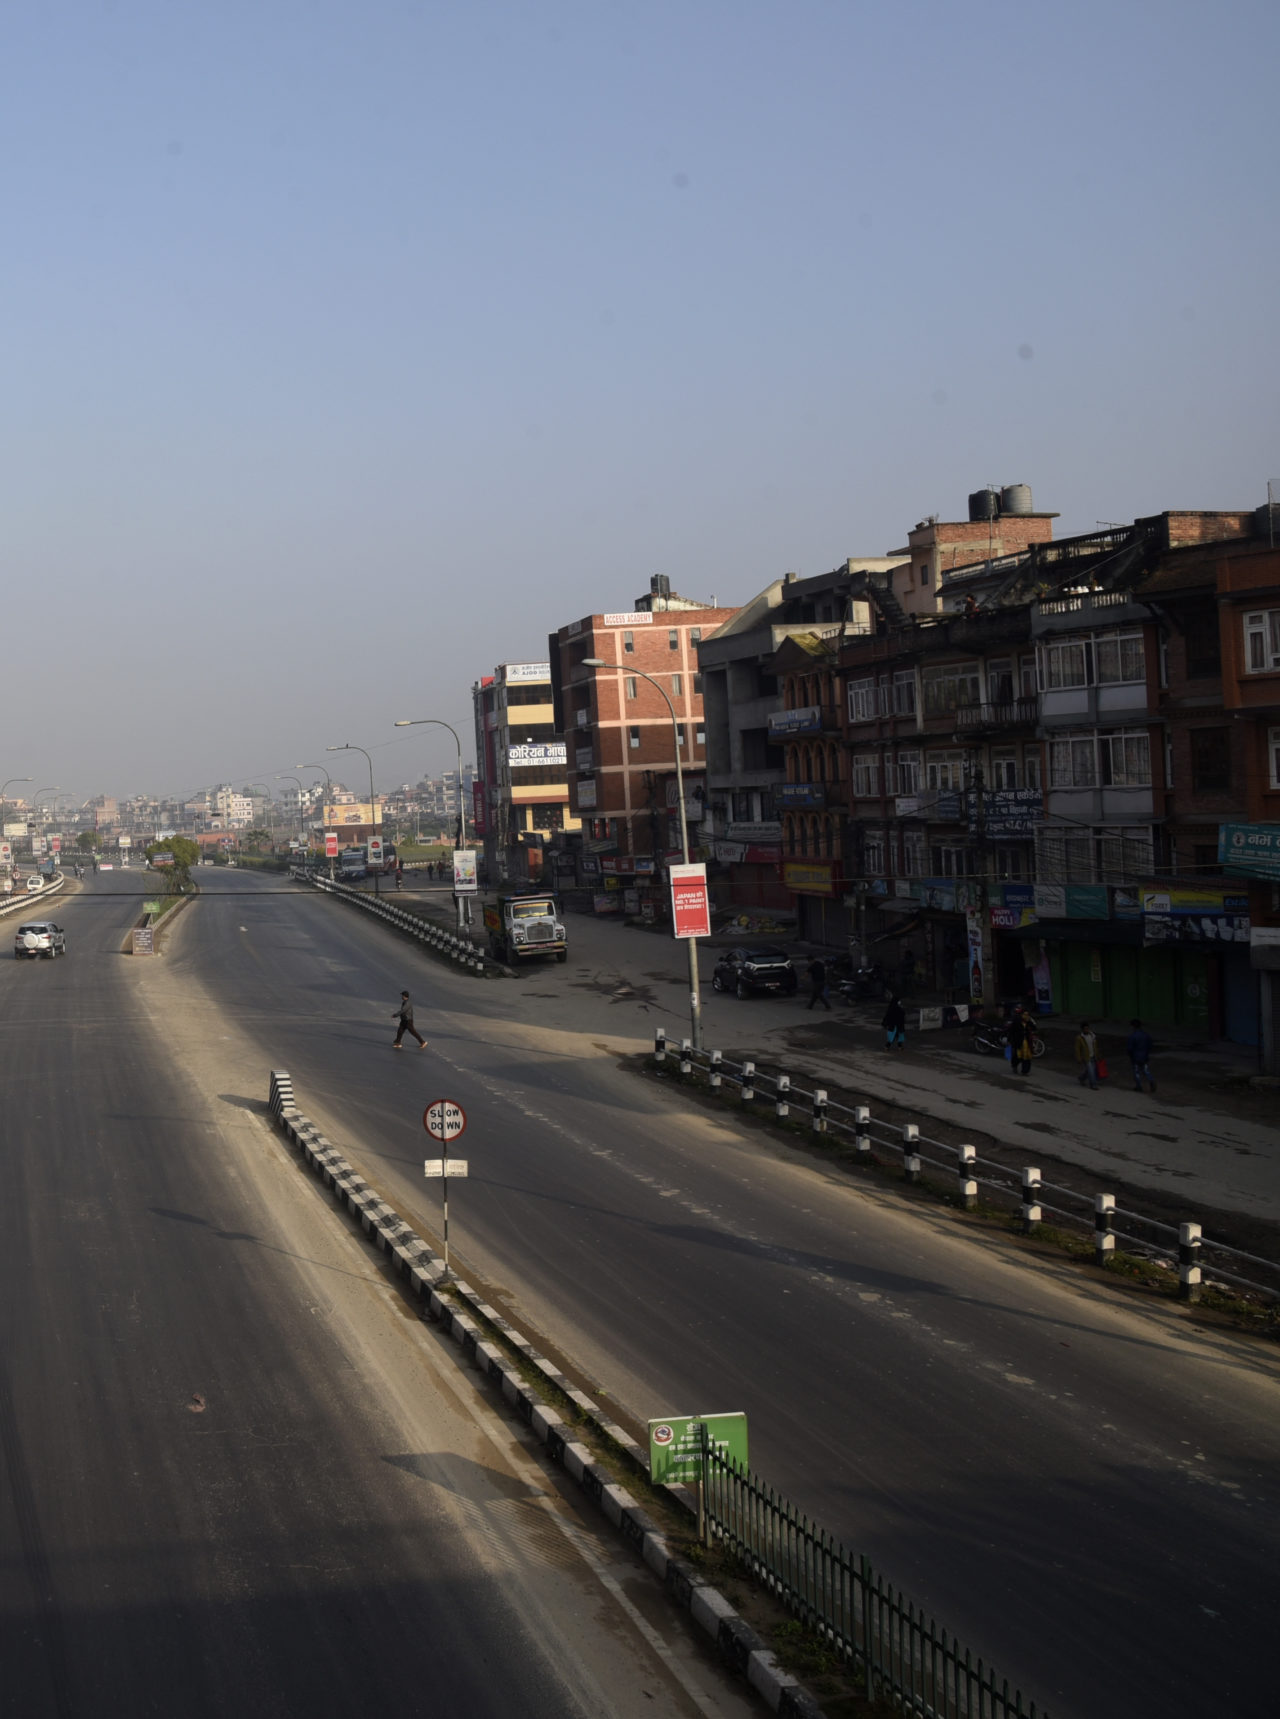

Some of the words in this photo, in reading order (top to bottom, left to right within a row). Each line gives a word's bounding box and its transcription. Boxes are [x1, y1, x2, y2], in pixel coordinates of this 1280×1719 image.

[605, 614, 626, 624] ACCESS
[627, 613, 652, 623] ACADEMY
[509, 744, 545, 758] कोरियन
[992, 915, 1013, 926] HOLI
[429, 1109, 459, 1118] SLOW
[431, 1121, 460, 1130] DOWN
